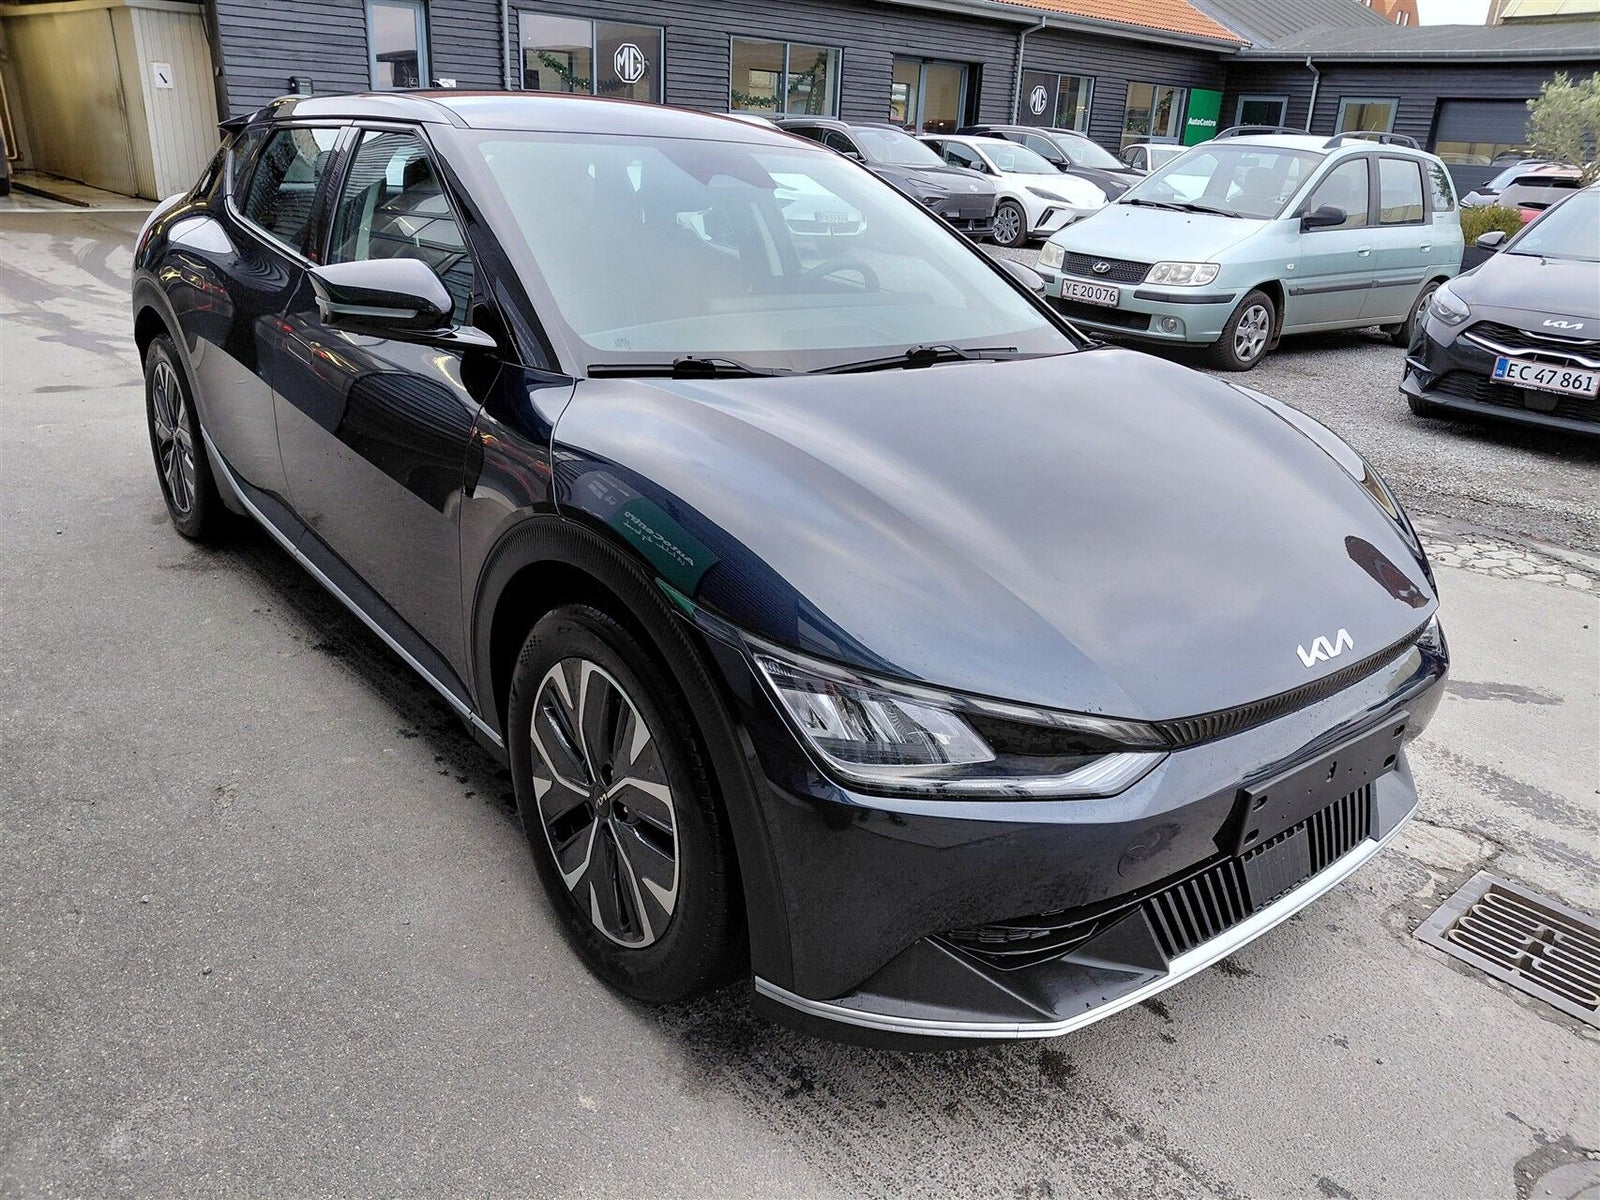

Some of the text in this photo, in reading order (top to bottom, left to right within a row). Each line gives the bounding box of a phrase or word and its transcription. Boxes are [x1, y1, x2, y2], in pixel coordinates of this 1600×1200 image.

[616, 46, 643, 80] MG
[1031, 87, 1046, 112] MG
[1187, 117, 1217, 127] AutoCentro
[1506, 363, 1532, 381] EC
[1534, 368, 1558, 384] 47
[1560, 372, 1593, 392] 861
[1296, 627, 1354, 668] KIA
